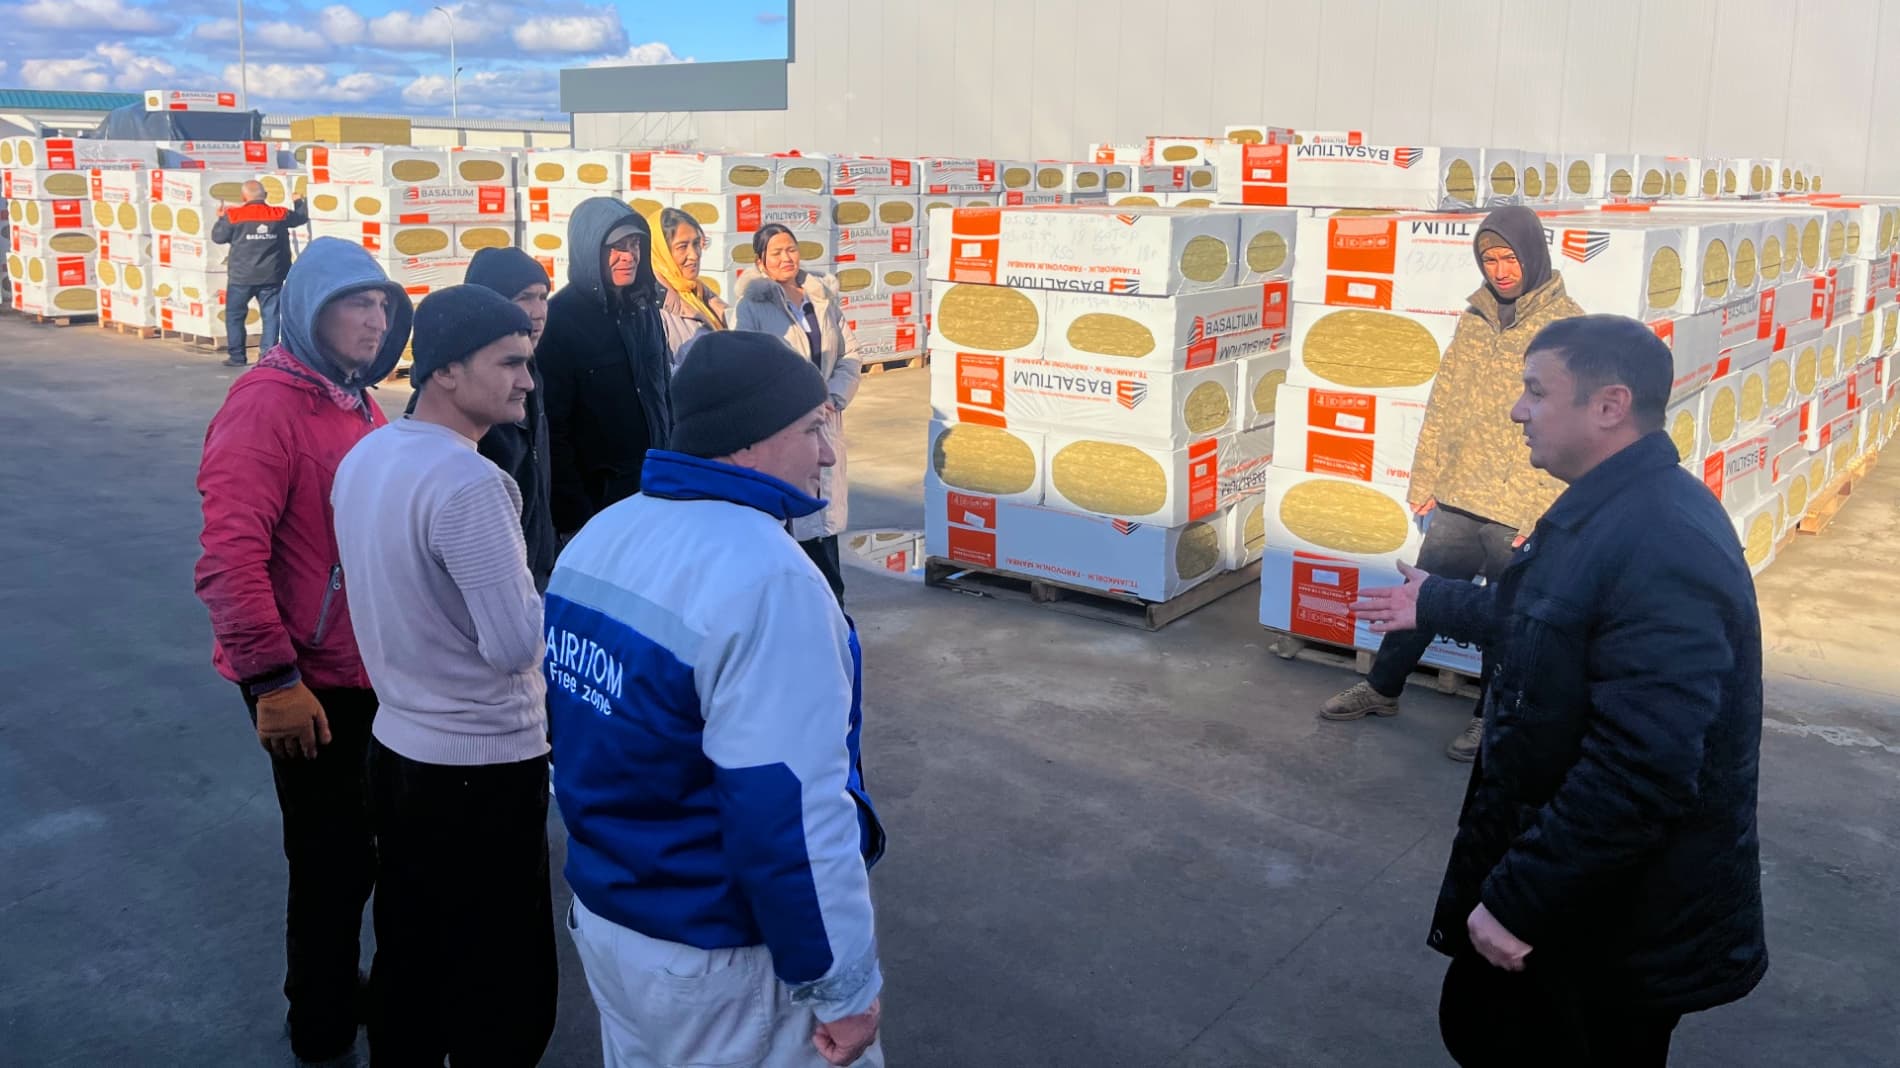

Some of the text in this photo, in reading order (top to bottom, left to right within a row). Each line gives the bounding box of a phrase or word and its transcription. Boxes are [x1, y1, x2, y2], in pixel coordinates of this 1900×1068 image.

[1296, 143, 1389, 161] BASALTIUM
[422, 188, 474, 198] BASALTIUM
[1037, 262, 1082, 273] FAROVONLIK
[1088, 265, 1141, 275] TEJAMKORLIK
[1006, 275, 1104, 292] BASALTIUM
[1205, 312, 1258, 337] BASALTIUM
[1013, 370, 1112, 395] BASALTIUM
[1386, 467, 1412, 479] NBAI
[545, 625, 623, 699] AIRITOM
[549, 661, 612, 715] Free zone
